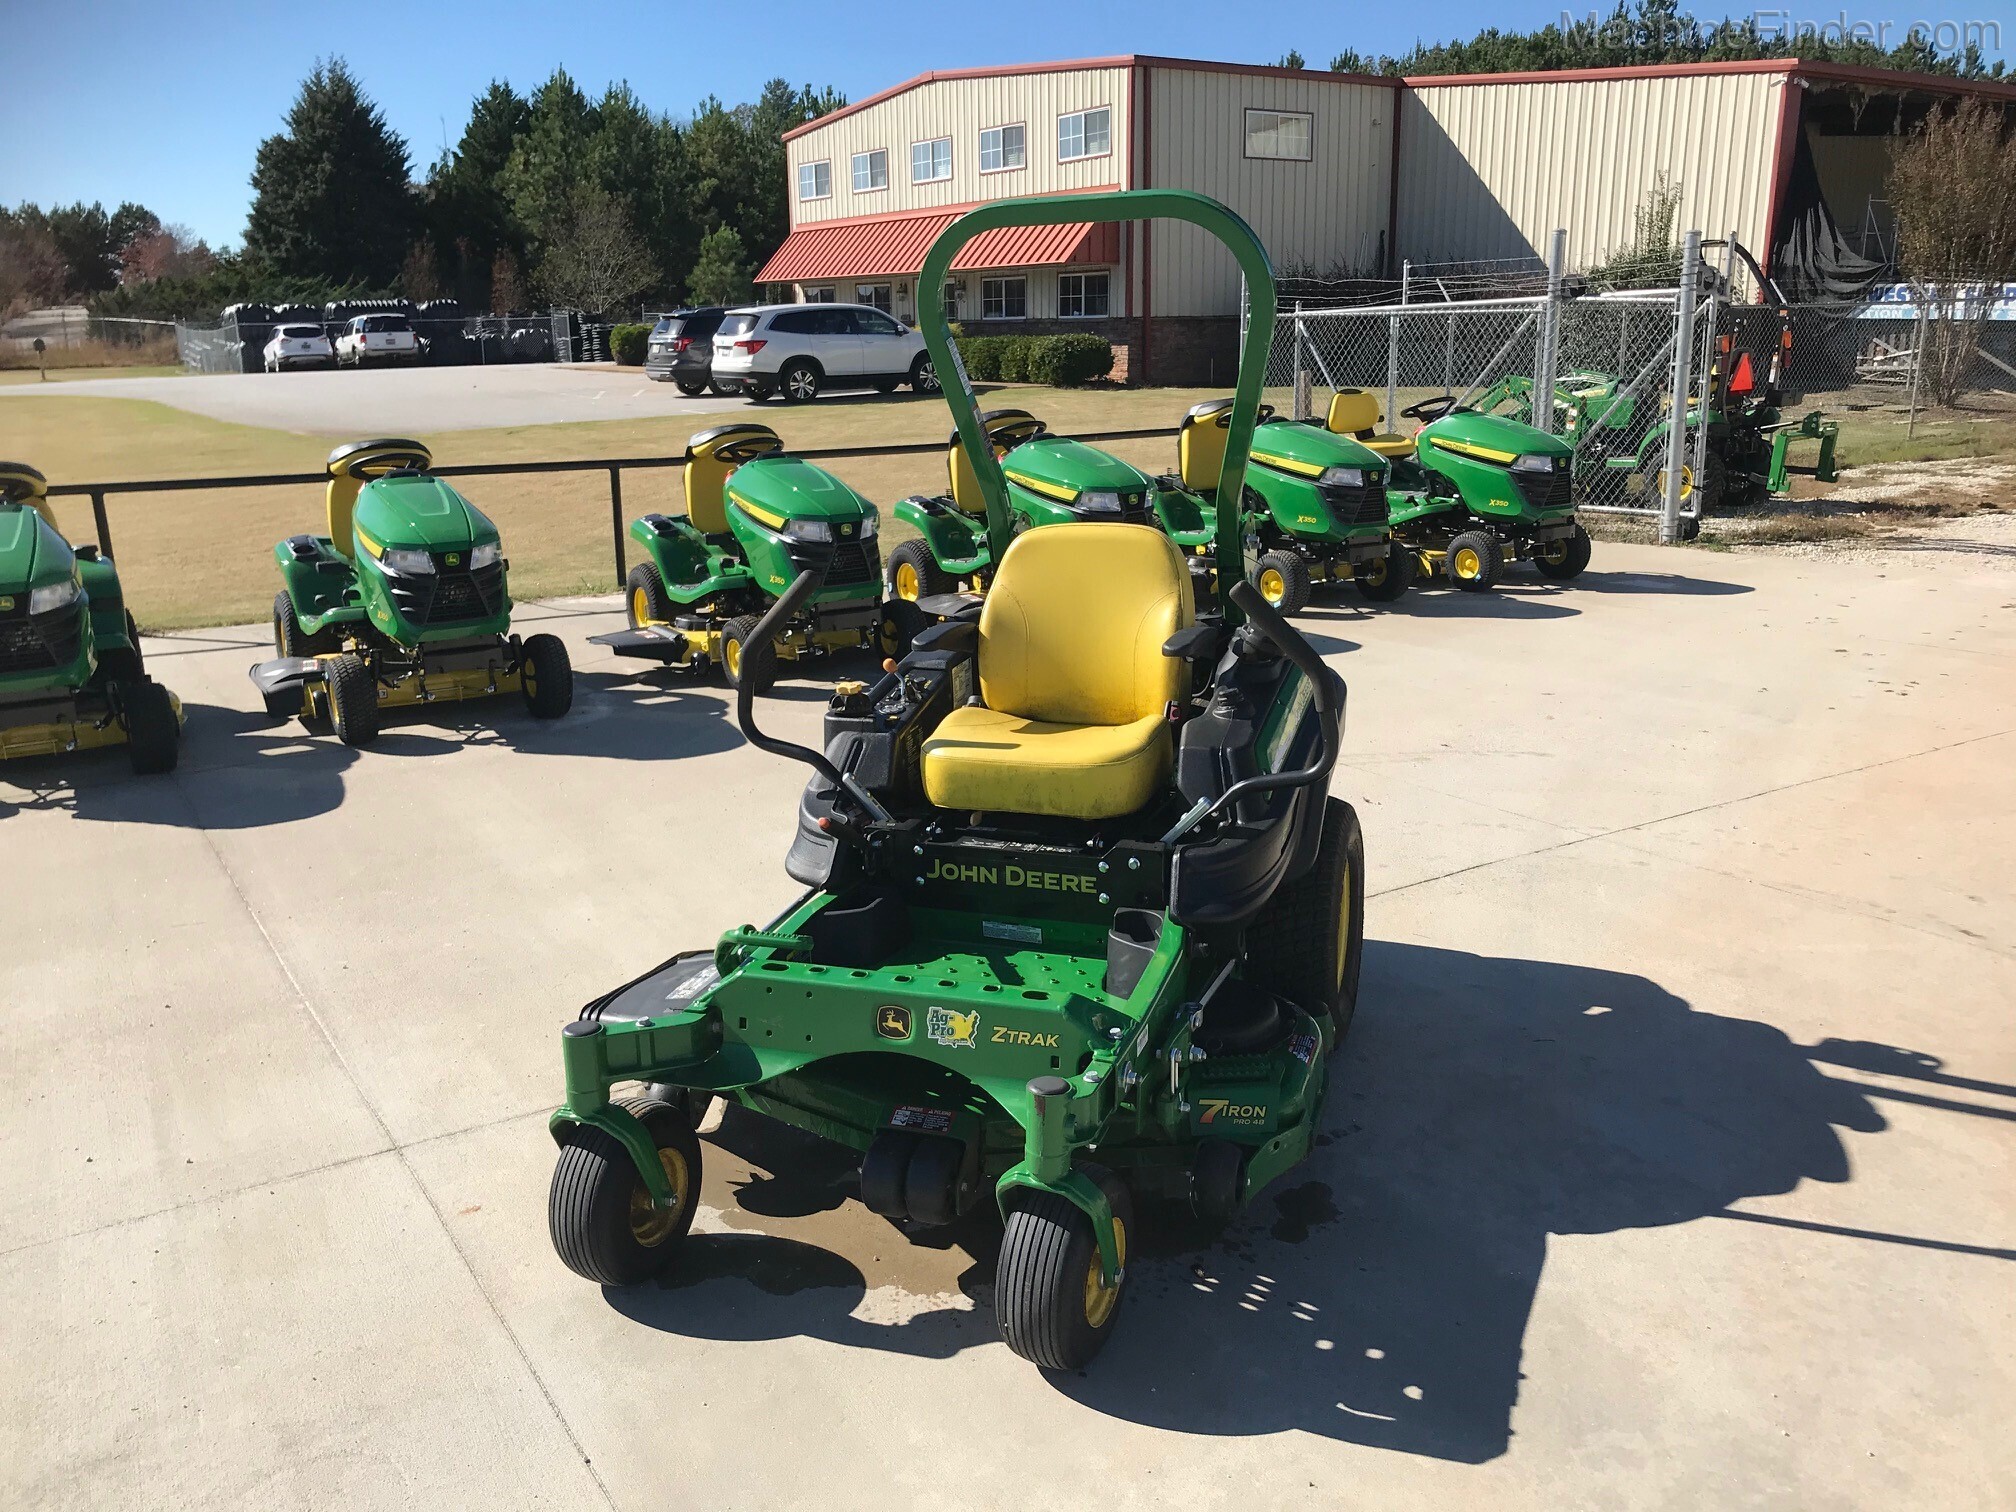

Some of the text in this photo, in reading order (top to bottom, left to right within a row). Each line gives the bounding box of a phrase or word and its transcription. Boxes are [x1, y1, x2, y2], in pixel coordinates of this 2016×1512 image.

[926, 859, 1098, 894] JOHN DEERE
[930, 1022, 956, 1036] Pro
[990, 1026, 1060, 1048] ZTRAK
